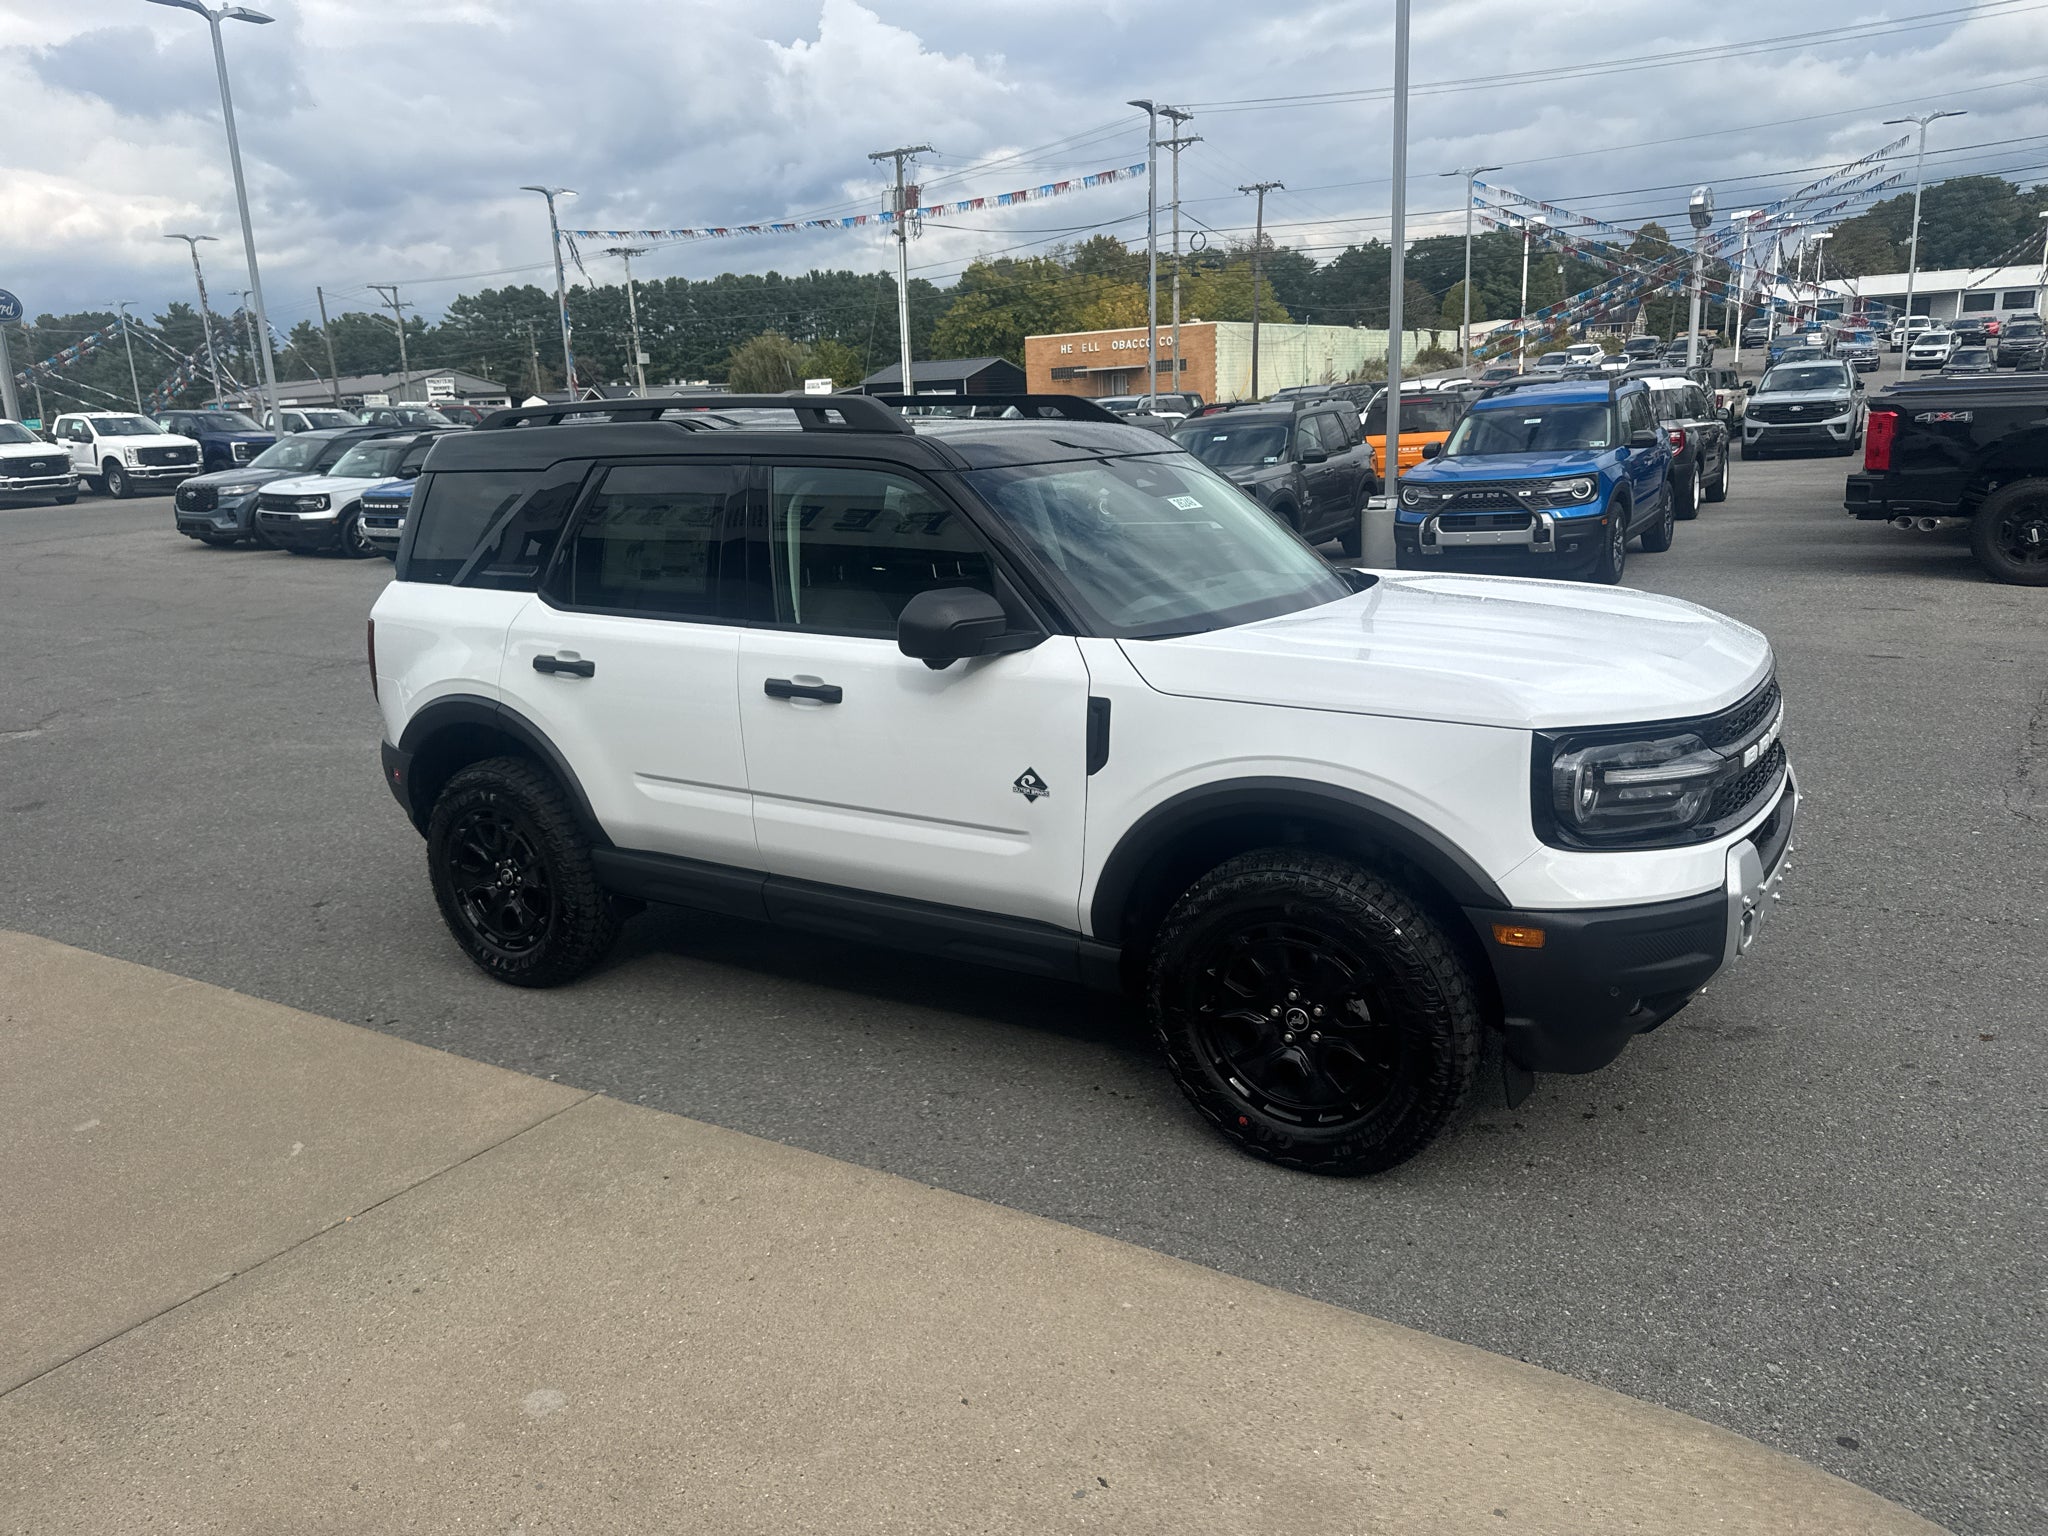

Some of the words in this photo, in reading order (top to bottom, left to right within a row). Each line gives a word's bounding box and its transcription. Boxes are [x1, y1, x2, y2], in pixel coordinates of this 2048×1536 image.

[1060, 344, 1073, 354] HE
[1081, 342, 1101, 353] ELL
[1158, 336, 1174, 347] CO
